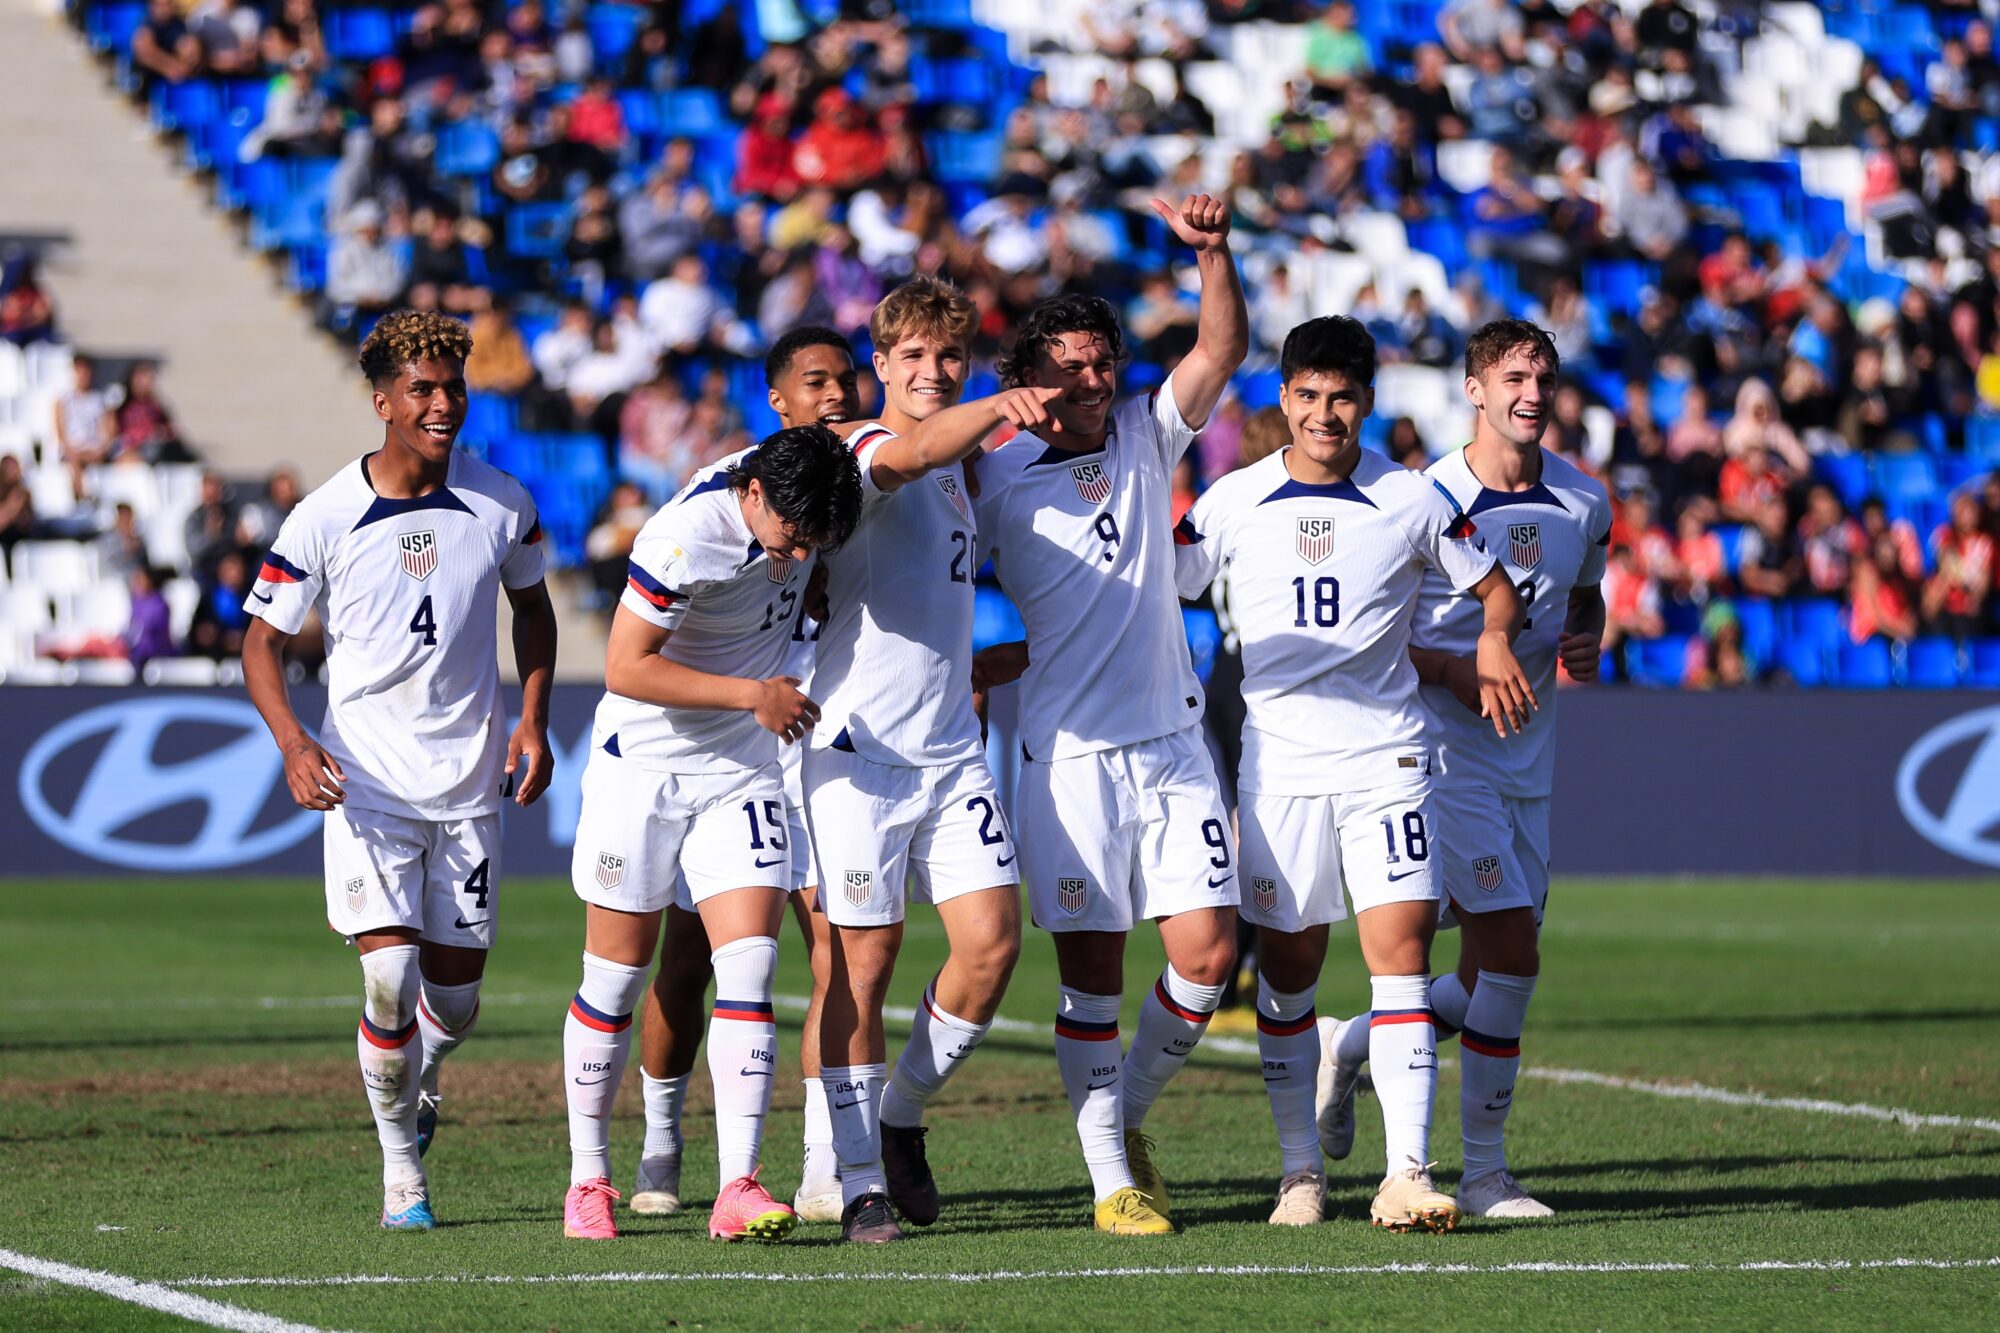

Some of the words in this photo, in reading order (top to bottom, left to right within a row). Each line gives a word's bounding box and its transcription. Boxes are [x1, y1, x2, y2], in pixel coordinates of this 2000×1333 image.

[1072, 464, 1101, 482] USA
[1095, 512, 1121, 562] 9
[1300, 520, 1331, 537] USA
[1510, 525, 1537, 544] USA
[401, 533, 432, 553] USA
[760, 575, 798, 631] 15
[1292, 576, 1340, 628] 18
[410, 595, 437, 646] 4
[742, 800, 788, 850] 15
[1201, 819, 1230, 869] 9
[1379, 811, 1429, 863] 18
[600, 854, 622, 869] USA
[1475, 858, 1497, 873] USA
[348, 879, 363, 893] USA
[464, 858, 490, 909] 4
[847, 873, 870, 886] USA
[1061, 880, 1084, 893] USA
[1255, 879, 1274, 892] USA
[751, 1049, 774, 1065] USA
[365, 1067, 398, 1084] USA
[582, 1062, 611, 1072] USA
[1091, 1065, 1116, 1076] USA
[836, 1081, 866, 1093] USA
